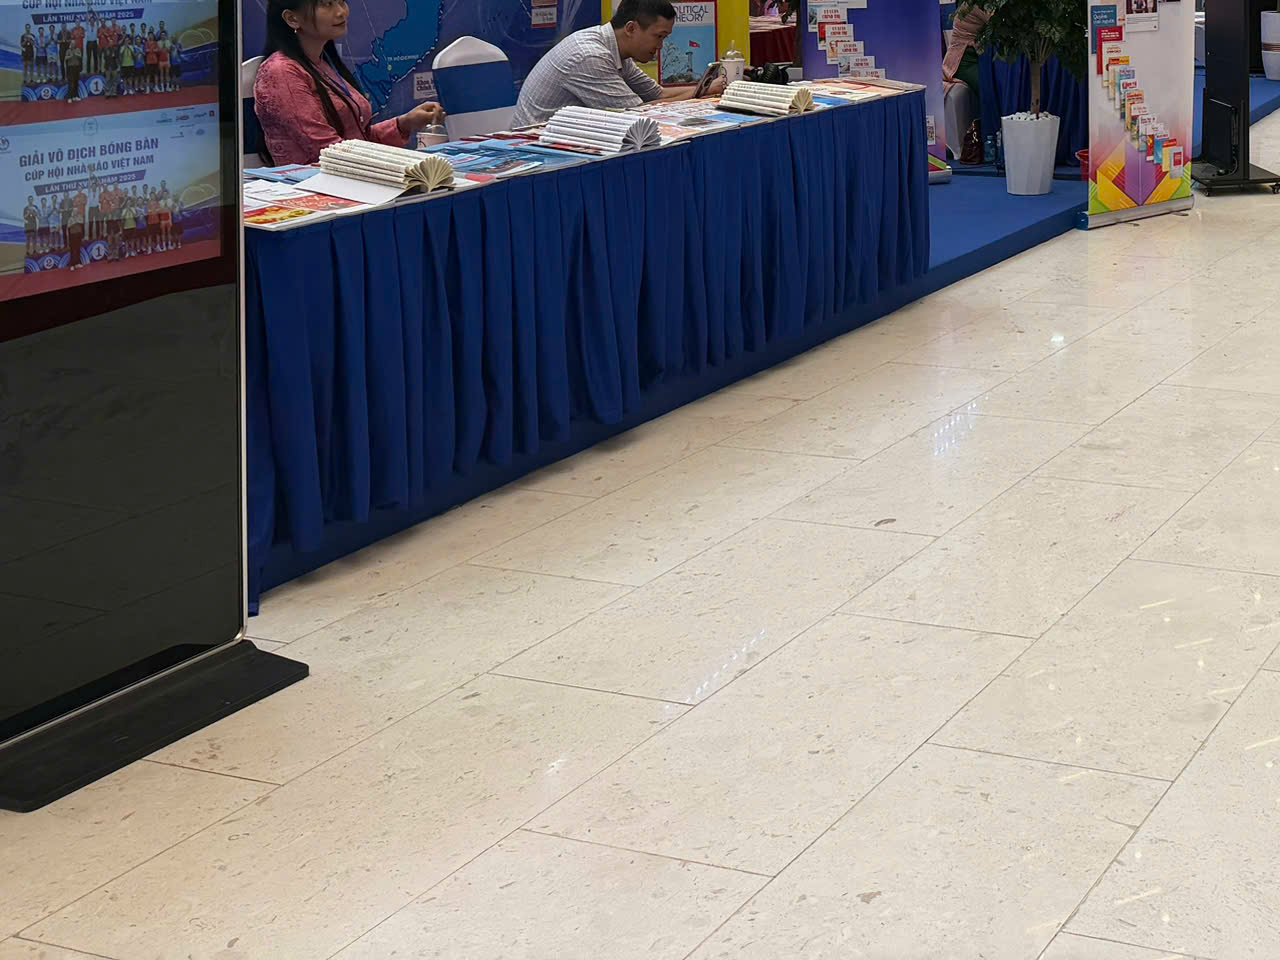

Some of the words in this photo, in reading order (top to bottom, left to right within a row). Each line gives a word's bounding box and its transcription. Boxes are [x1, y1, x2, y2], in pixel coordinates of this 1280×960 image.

[19, 149, 45, 168] GIẢI
[47, 148, 64, 163] VÔ
[67, 146, 96, 161] ĐỊCH
[99, 141, 132, 156] BÓNG
[135, 136, 159, 152] BÀN
[24, 168, 45, 182] CÚP
[47, 166, 64, 180] HỘI
[66, 163, 87, 177] NHÀ
[110, 158, 131, 171] VIỆT
[133, 154, 155, 166] NAM
